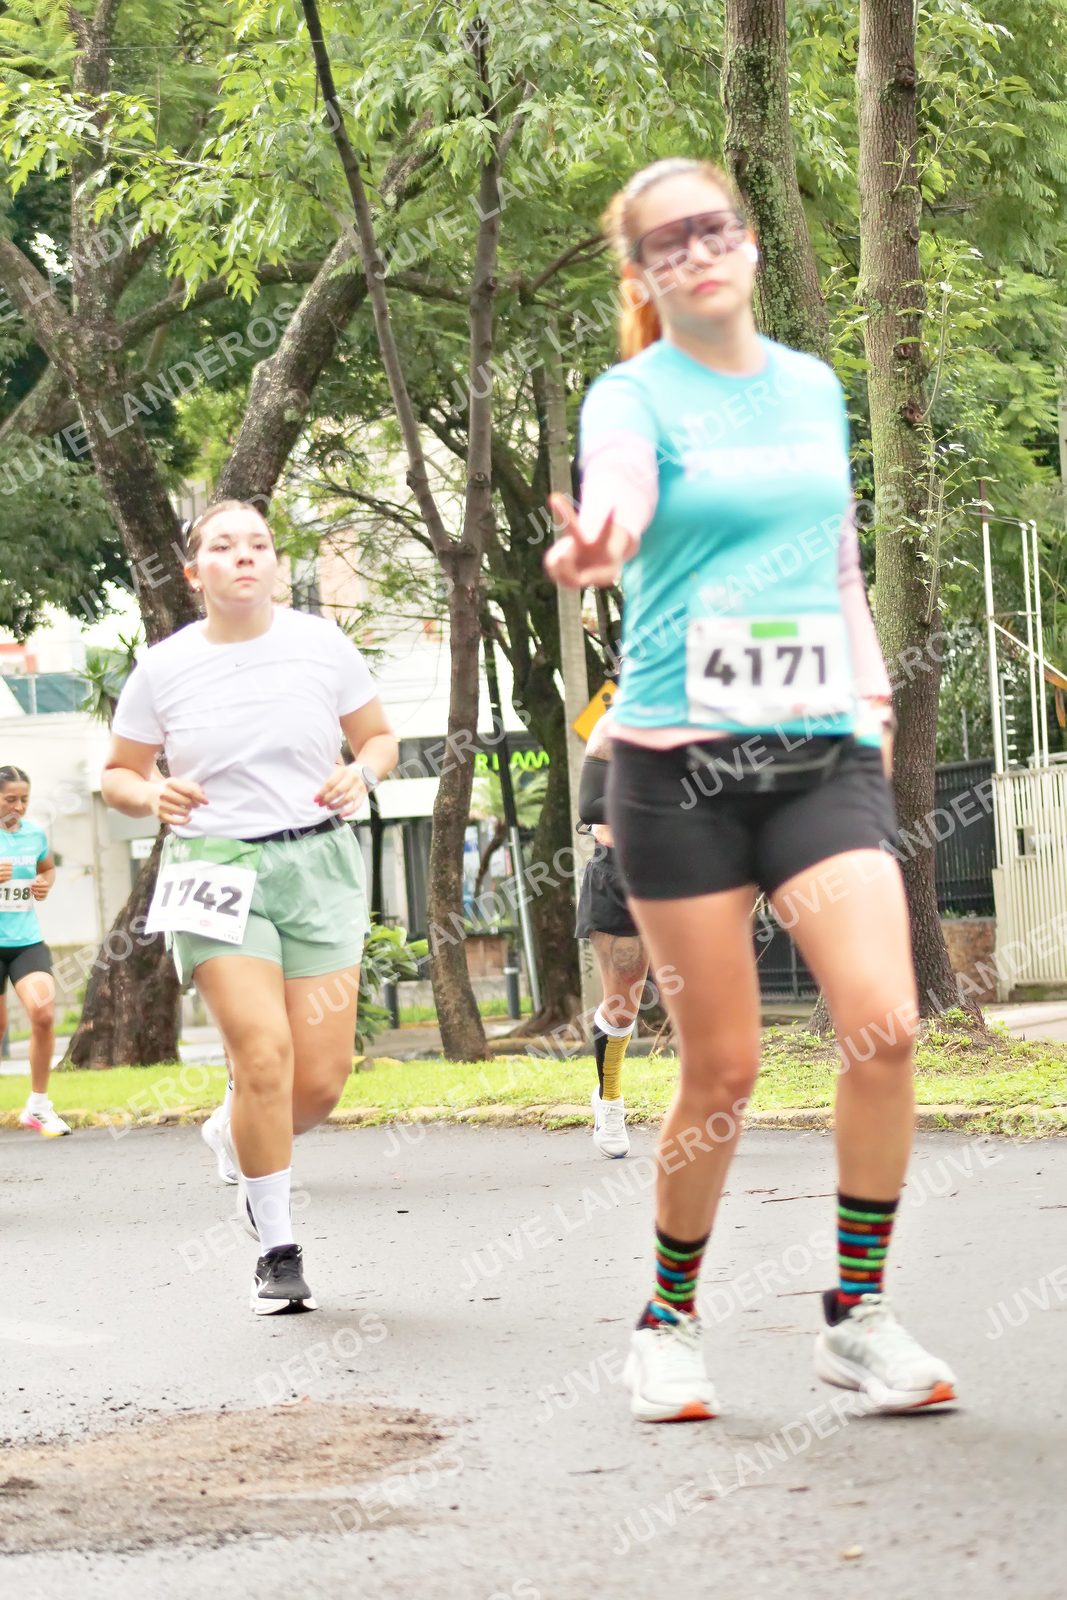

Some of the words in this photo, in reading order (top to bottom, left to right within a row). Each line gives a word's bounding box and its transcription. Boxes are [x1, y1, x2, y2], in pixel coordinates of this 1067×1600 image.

[703, 645, 826, 687] 4171
[0, 886, 31, 901] 198
[160, 878, 243, 917] 1742
